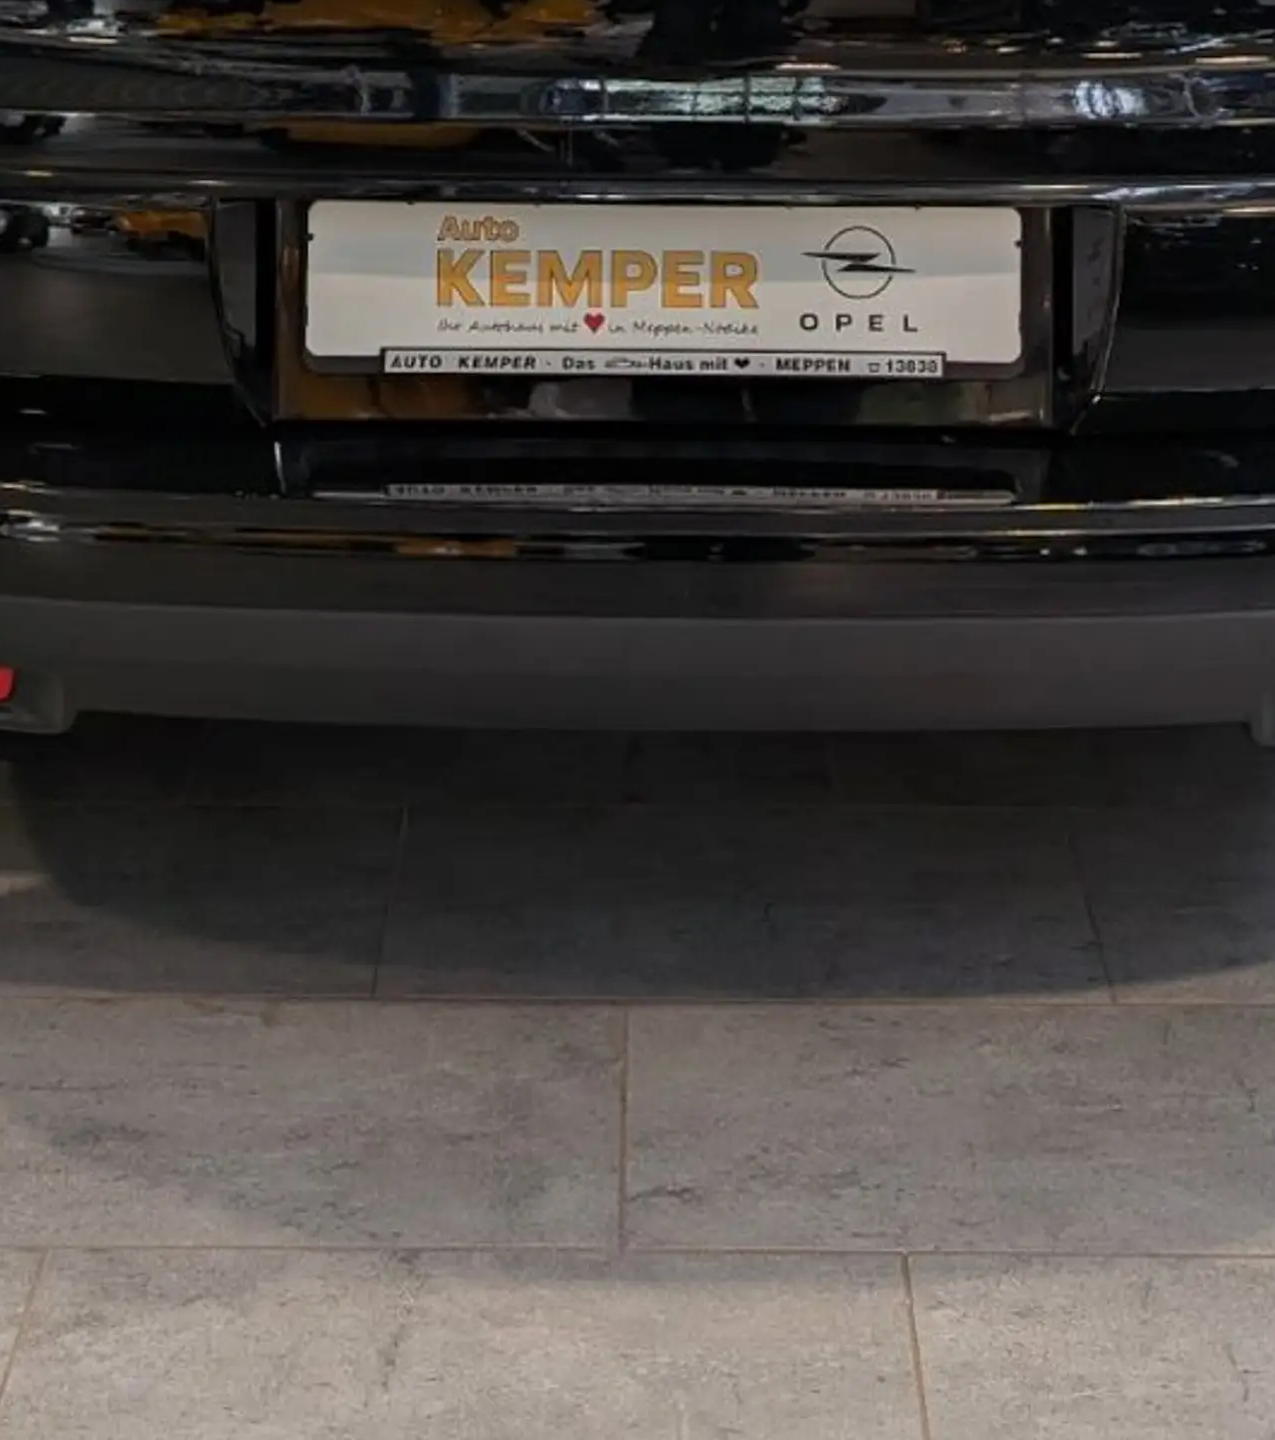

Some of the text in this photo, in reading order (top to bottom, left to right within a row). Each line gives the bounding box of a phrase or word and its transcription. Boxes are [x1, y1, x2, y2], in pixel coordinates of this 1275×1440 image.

[437, 215, 520, 242] Auto
[436, 248, 759, 308] KEMPER
[799, 313, 918, 333] OPEL
[390, 355, 442, 368] AUTO
[458, 356, 537, 369] KEMPER
[562, 356, 595, 370] Das
[776, 358, 851, 372] MEPPEN
